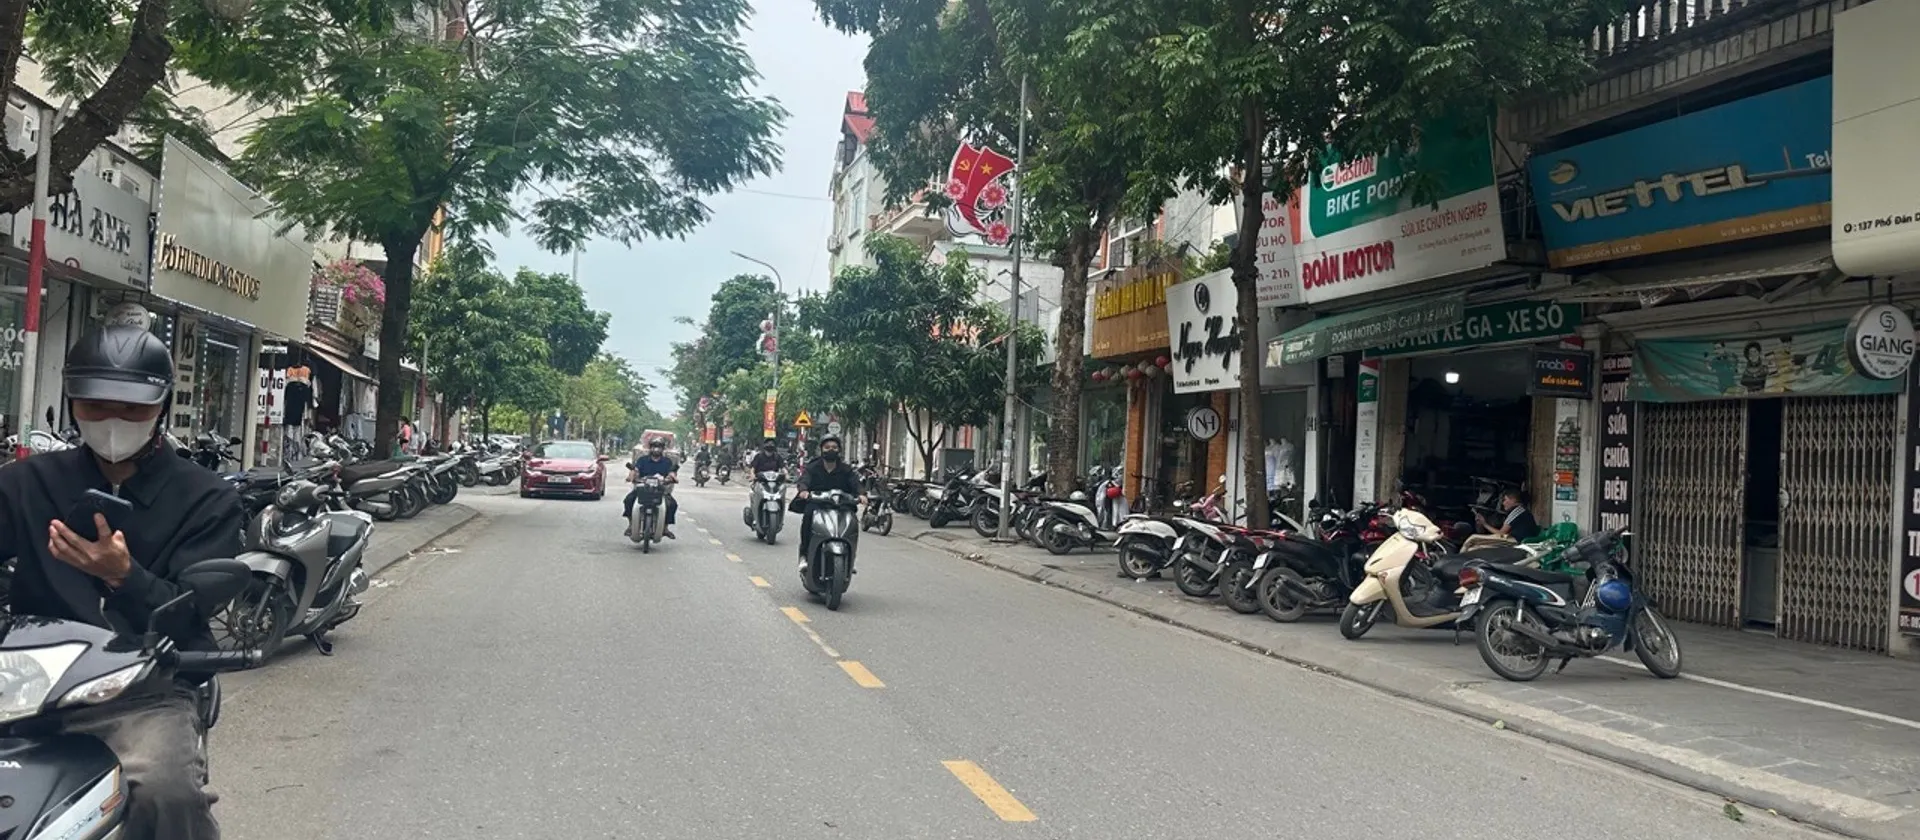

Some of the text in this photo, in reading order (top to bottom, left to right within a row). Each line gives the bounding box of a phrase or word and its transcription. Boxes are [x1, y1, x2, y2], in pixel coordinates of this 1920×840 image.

[1805, 149, 1833, 169] Tel
[1326, 189, 1361, 217] BIKE
[1262, 216, 1285, 228] TOR
[1859, 220, 1873, 231] 137
[1875, 215, 1892, 228] Phố
[1271, 267, 1290, 280] 21h
[1302, 240, 1396, 290] ĐOÀN MOTOR
[1466, 314, 1494, 339] GA
[1506, 308, 1532, 334] XE
[1534, 301, 1564, 331] SỐ
[1354, 321, 1382, 340] MOTOR
[1860, 334, 1913, 355] GIANG
[1603, 442, 1630, 468] CHỮA
